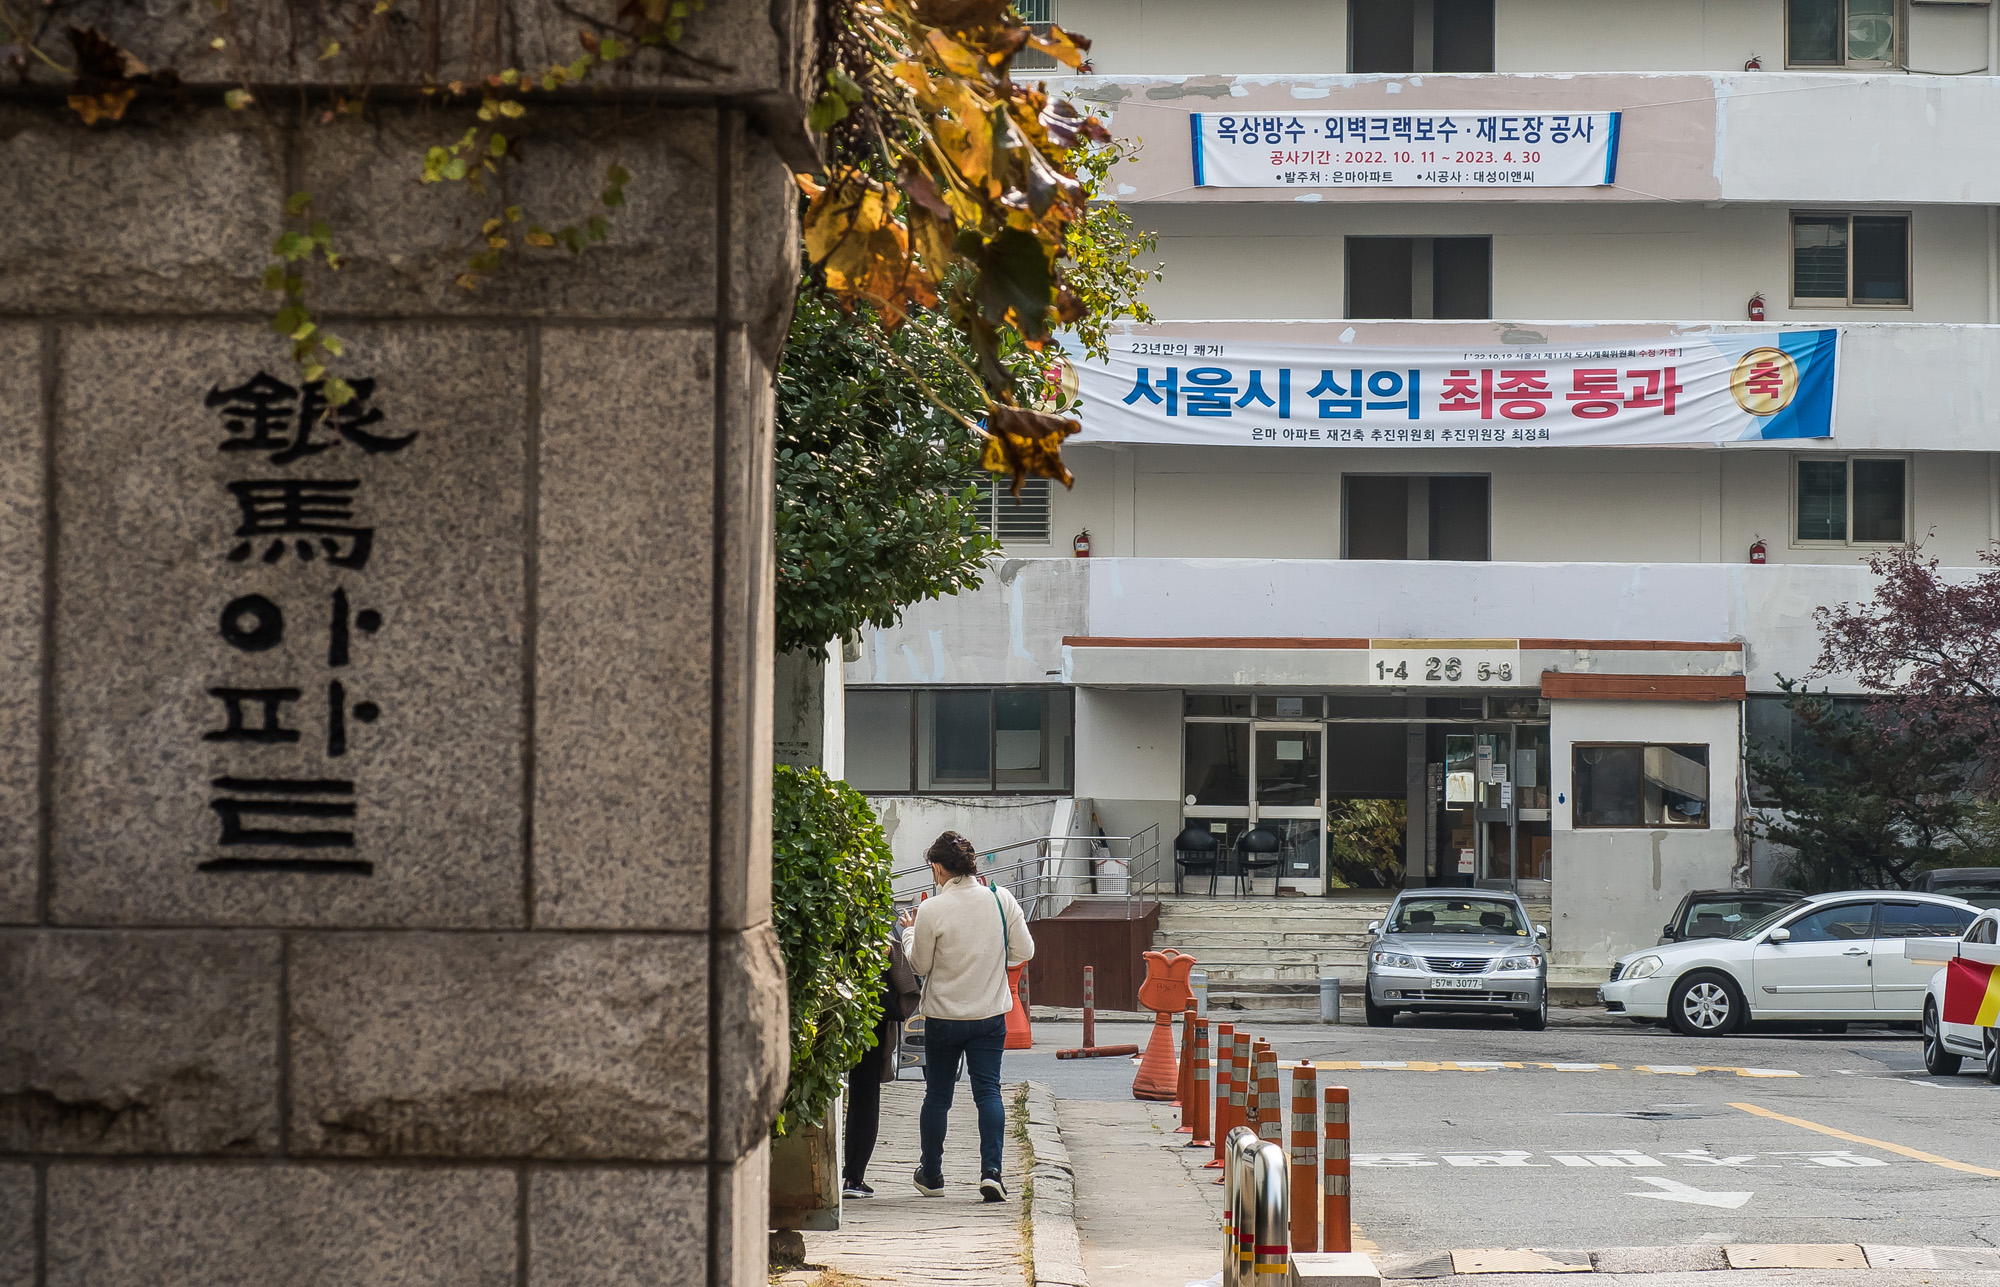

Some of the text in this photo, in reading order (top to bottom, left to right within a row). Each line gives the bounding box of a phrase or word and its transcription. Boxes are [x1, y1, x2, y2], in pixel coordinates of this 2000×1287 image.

[1217, 117, 1306, 145] 옥상방수
[1324, 117, 1458, 144] 외벽크랙보수
[1476, 117, 1544, 144] 재도장
[1549, 116, 1594, 144] 공사
[1269, 151, 1331, 165] 공사기간
[1345, 152, 1387, 164] 2022.
[1393, 152, 1415, 164] 10.
[1421, 152, 1435, 163] 11
[1456, 152, 1498, 164] 2023.
[1503, 152, 1517, 164] 4.
[1521, 152, 1541, 164] 30
[1284, 171, 1320, 184] 발주처
[1332, 171, 1394, 183] 은마아파트
[1425, 171, 1462, 183] 시공사
[1473, 171, 1534, 183] 대성이앤씨
[1131, 343, 1224, 357] 23년만의 쾌거!
[1638, 349, 1656, 358] 수정
[1745, 361, 1783, 399] 축
[1122, 367, 1291, 419] 서울시
[1306, 369, 1420, 419] 심의
[1438, 368, 1552, 420] 최종
[1565, 367, 1683, 419] 통과
[1251, 427, 1550, 442] 은마 아파트 재건축 추진위원회 추진위원장 최정희
[1375, 657, 1513, 682] 1-4 26 5-8
[1456, 979, 1478, 988] 3077
